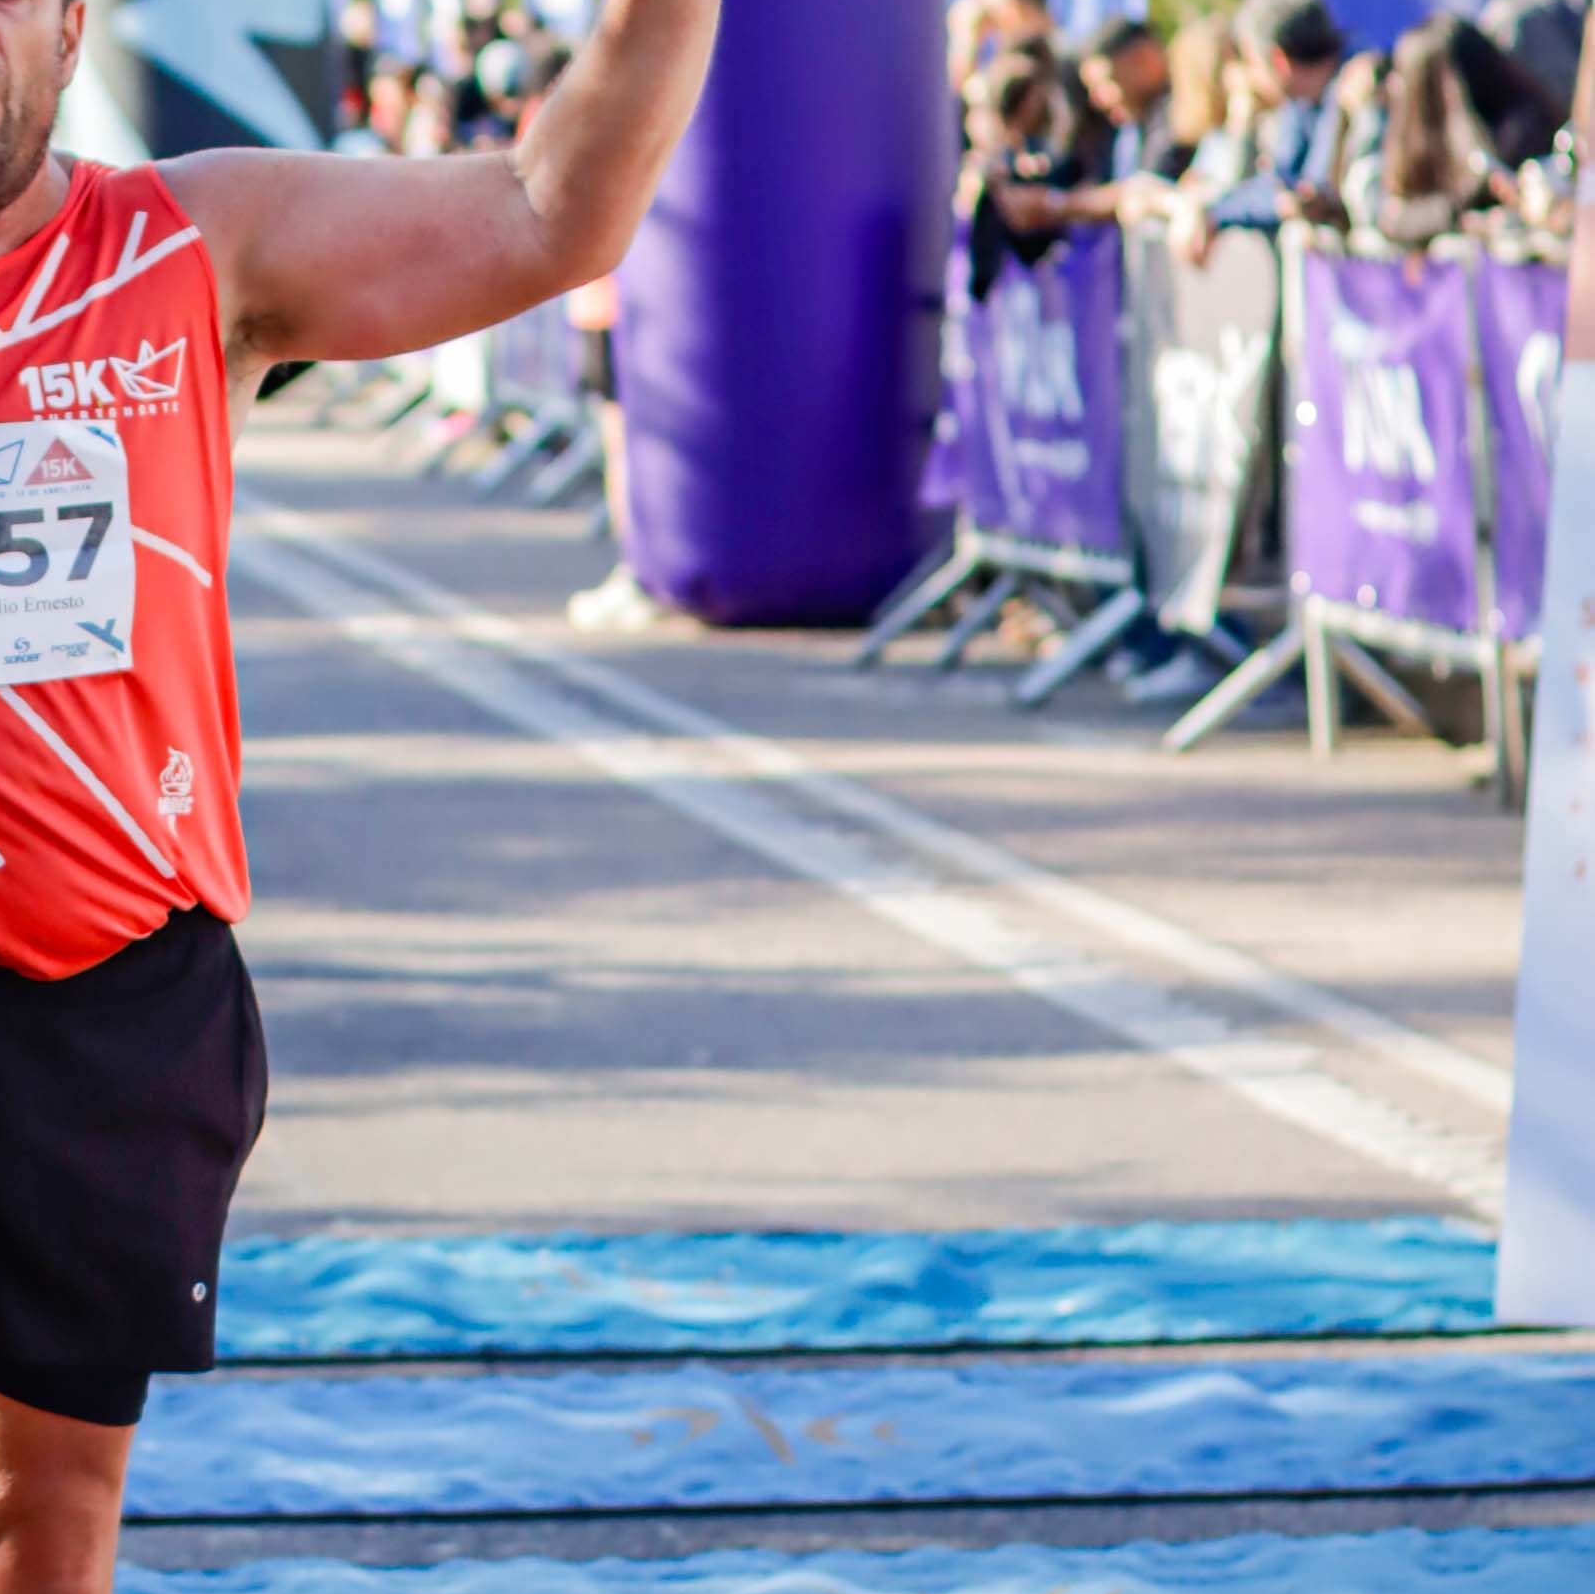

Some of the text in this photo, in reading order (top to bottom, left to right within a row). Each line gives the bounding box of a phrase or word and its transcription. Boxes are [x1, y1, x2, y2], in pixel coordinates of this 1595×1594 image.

[19, 359, 115, 411] 15K
[40, 458, 80, 479] 15K
[23, 595, 86, 613] Ernesto
